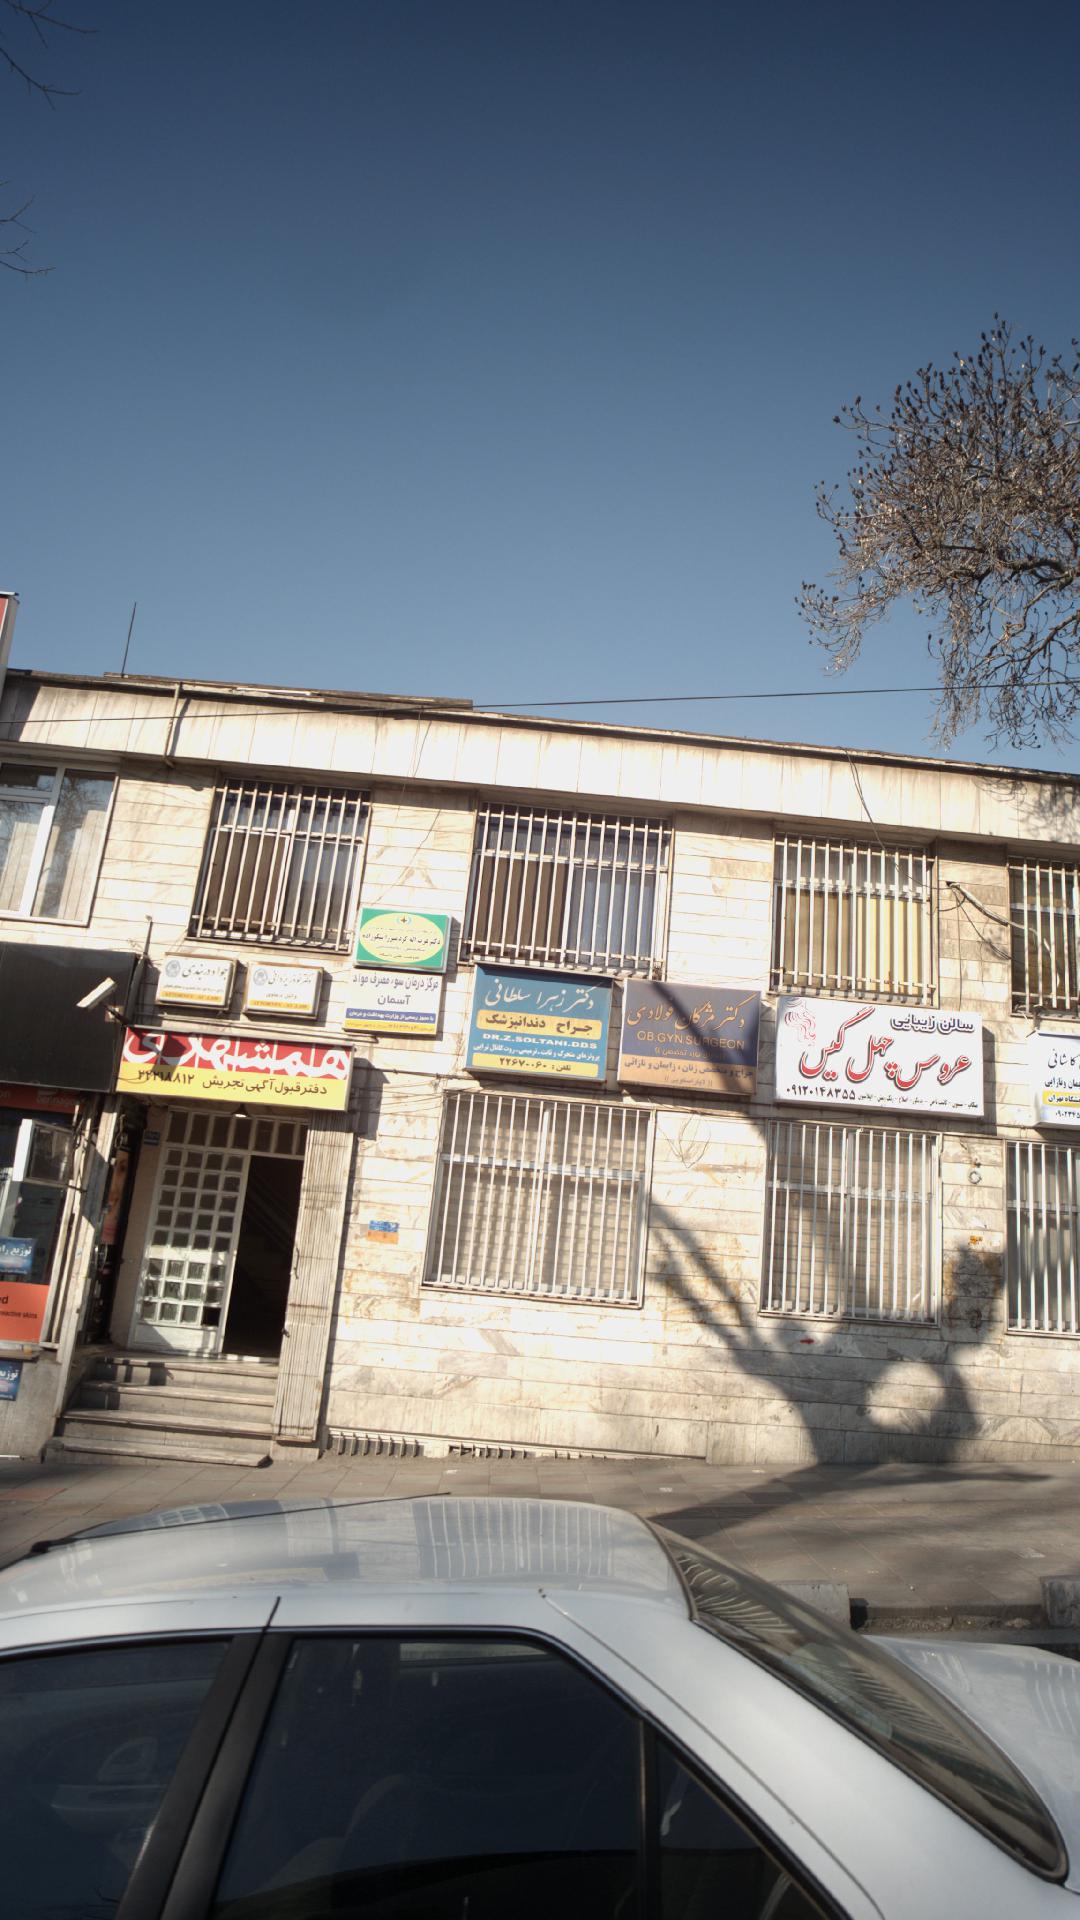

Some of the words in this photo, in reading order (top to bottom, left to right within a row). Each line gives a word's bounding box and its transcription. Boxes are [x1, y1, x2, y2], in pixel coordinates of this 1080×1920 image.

[353, 973, 369, 987] مواد
[370, 972, 390, 987] مصرف
[405, 976, 424, 990] درمان
[424, 977, 439, 991] مرکز
[377, 994, 412, 1006] آسمان
[484, 978, 532, 1007] سلطانی
[536, 989, 567, 1012] زهرا
[562, 981, 605, 1013] دکتر
[627, 1003, 674, 1026] فولادی
[674, 1000, 716, 1030] مژگان
[713, 991, 757, 1031] دکتر
[485, 1014, 546, 1030] دندانپزشک
[556, 1020, 593, 1036] جراح
[890, 1013, 937, 1033] زیبایی
[937, 1015, 975, 1033] سالن
[800, 1004, 876, 1081] گیس
[122, 1032, 350, 1080] همشهری
[499, 1057, 547, 1068] ۲۲۶۷۰۰۶۰
[845, 1034, 898, 1083] چهل
[653, 1060, 676, 1073] زایمان
[681, 1064, 698, 1075] زنان
[894, 1054, 972, 1091] عروس
[203, 1075, 244, 1091] تجریش
[246, 1079, 276, 1092] آگهی
[275, 1081, 300, 1096] قبول
[300, 1083, 328, 1095] دفتر
[786, 1083, 856, 1100] ۰۹۱۲۰۱۴۸۳۵۵
